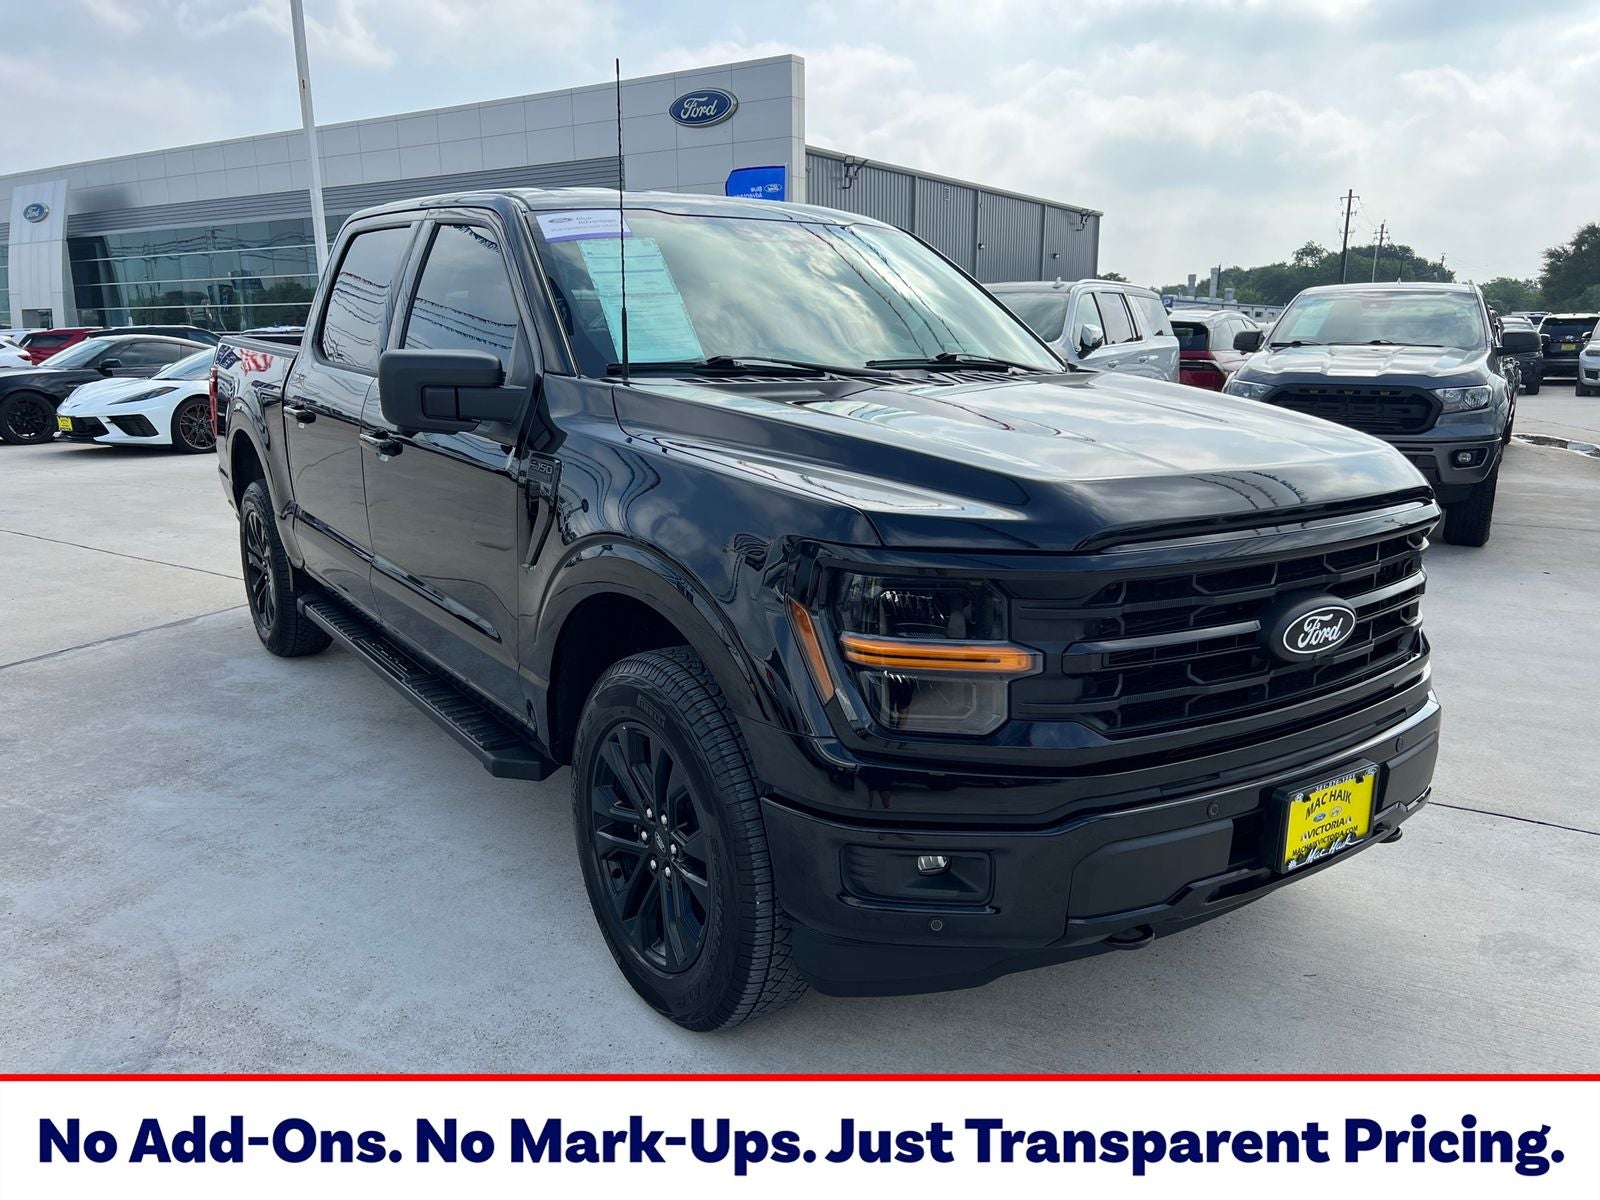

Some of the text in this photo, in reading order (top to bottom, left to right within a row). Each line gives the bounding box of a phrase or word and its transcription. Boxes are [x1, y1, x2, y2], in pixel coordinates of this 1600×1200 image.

[680, 96, 718, 120] Ford
[26, 206, 40, 218] Ford
[1297, 613, 1344, 649] Ford
[1305, 792, 1328, 820] MAC
[1329, 789, 1352, 804] HAIK
[1307, 817, 1345, 839] VICTORIA
